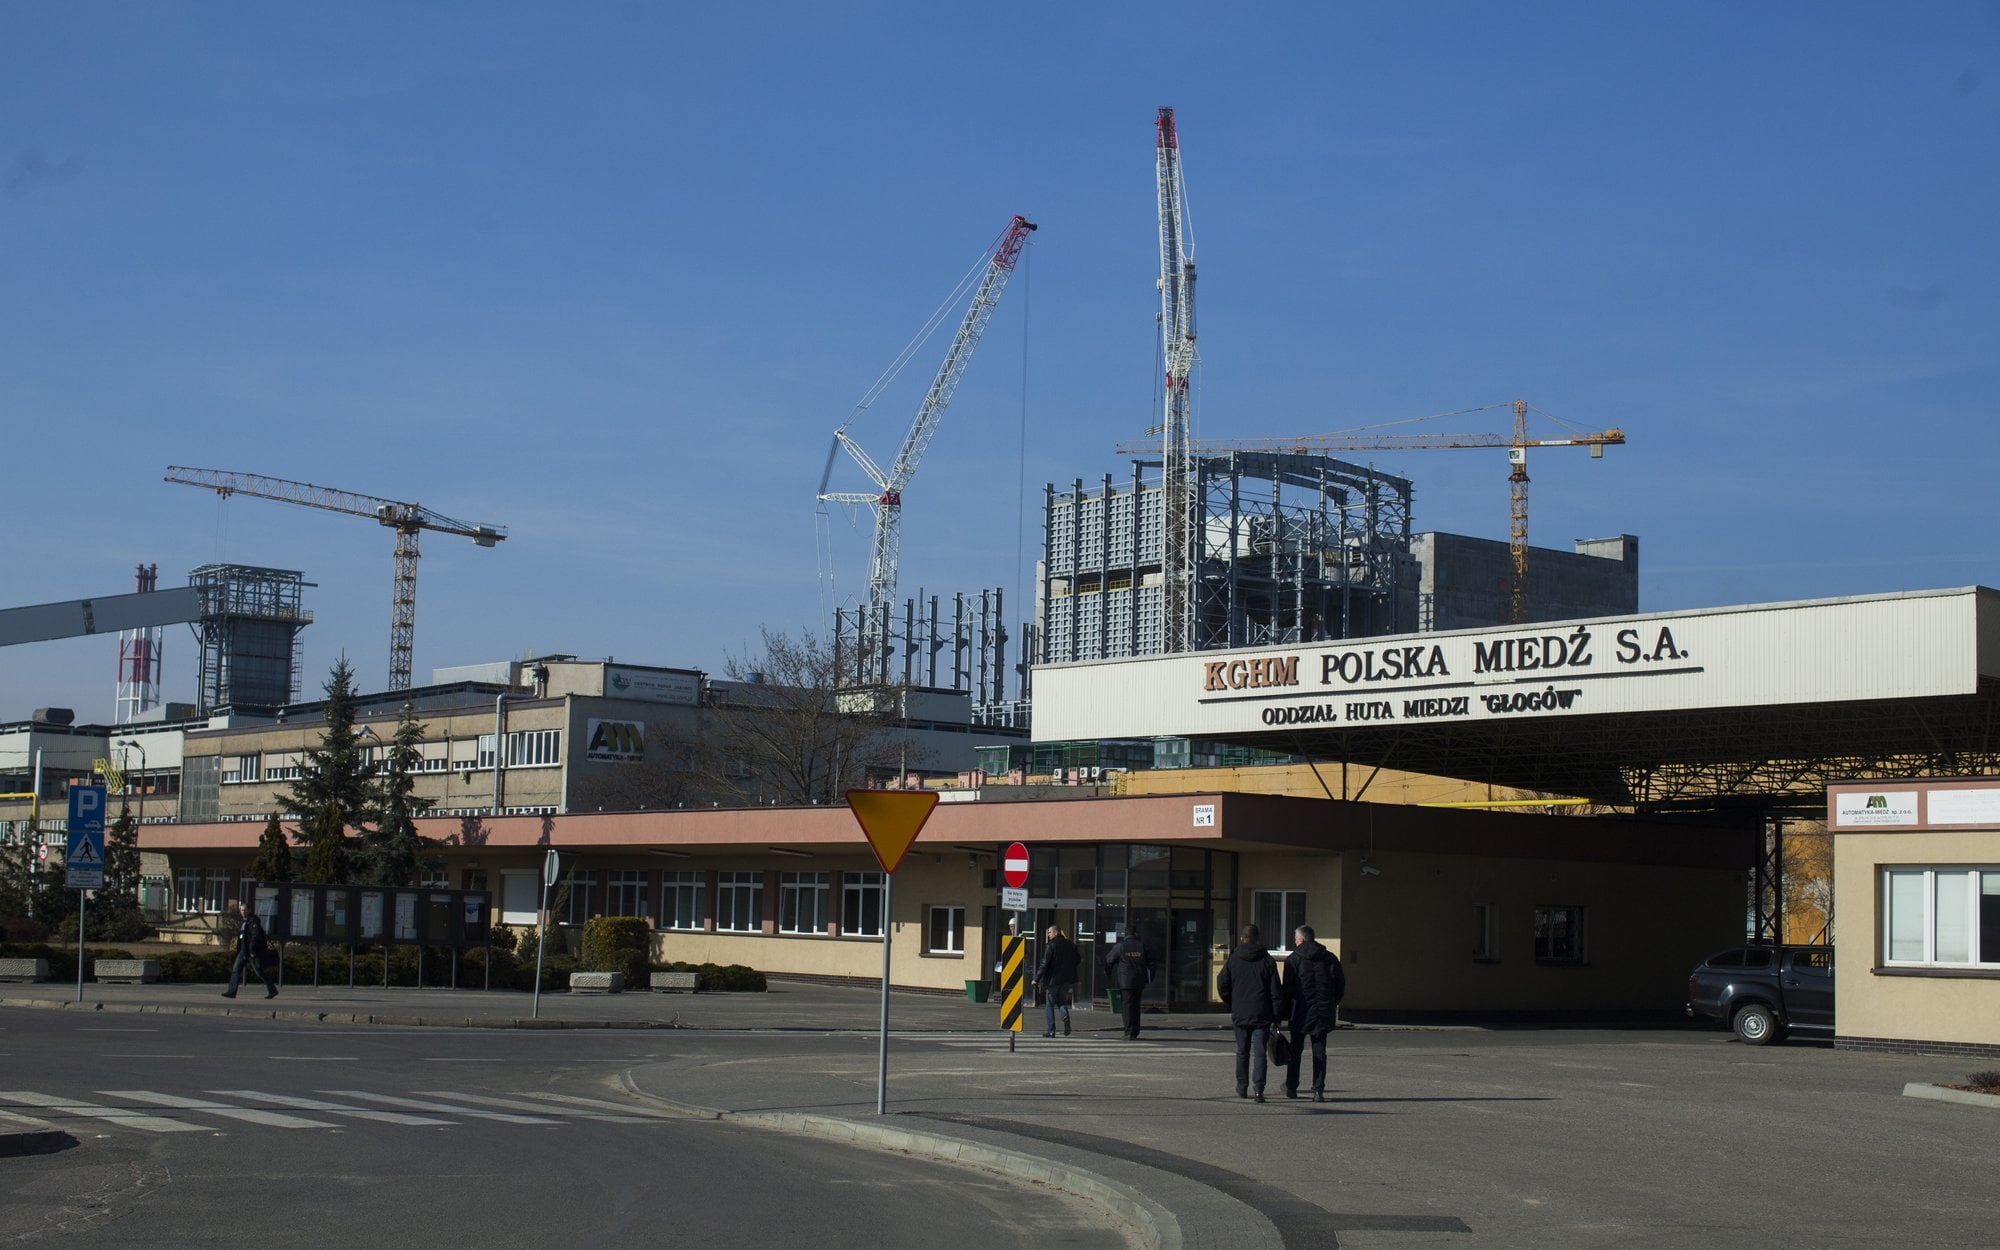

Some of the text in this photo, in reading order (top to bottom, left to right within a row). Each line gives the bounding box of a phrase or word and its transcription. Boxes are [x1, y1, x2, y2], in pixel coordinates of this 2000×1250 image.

[1204, 625, 1688, 690] KGHM POLSKA MIEDŹ S.A.
[1262, 704, 1337, 726] ODDZIAŁ
[1345, 701, 1395, 721] HUTA
[1403, 696, 1470, 719] MIEDZI
[77, 789, 99, 818] P
[1206, 814, 1211, 824] 1
